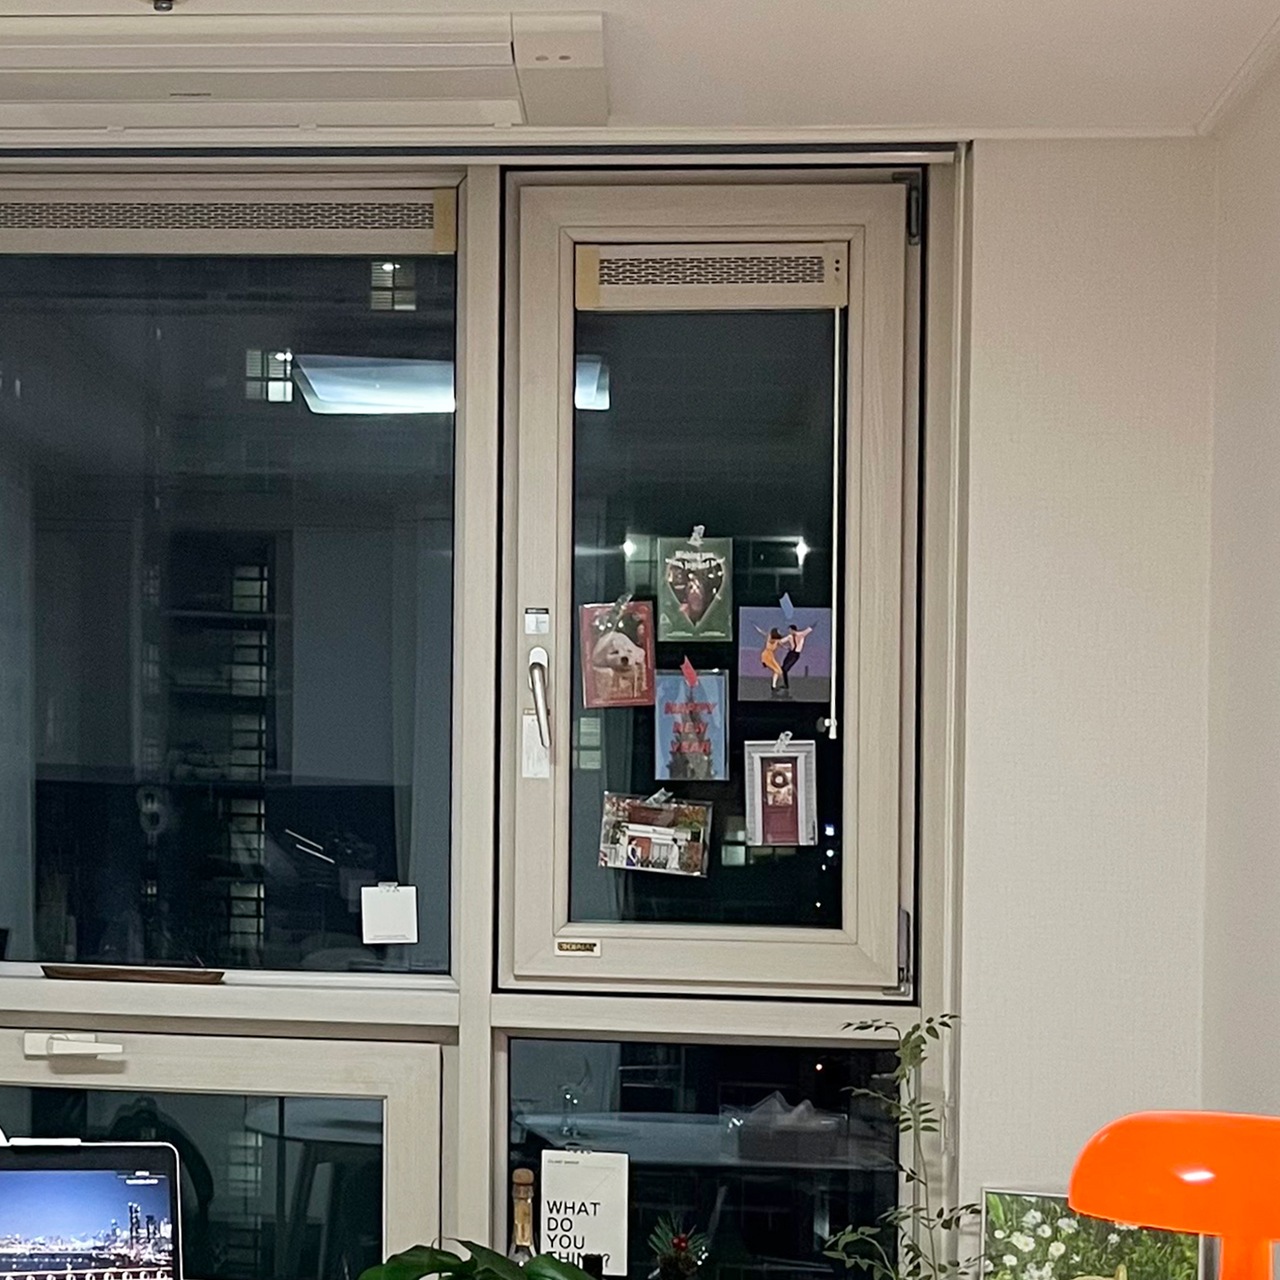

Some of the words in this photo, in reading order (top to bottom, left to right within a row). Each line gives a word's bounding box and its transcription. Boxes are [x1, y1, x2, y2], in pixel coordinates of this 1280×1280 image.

[672, 721, 708, 734] NEW
[670, 740, 712, 754] YEAR
[546, 1200, 601, 1217] WHAT
[547, 1216, 573, 1233] DO
[546, 1234, 585, 1250] YOU
